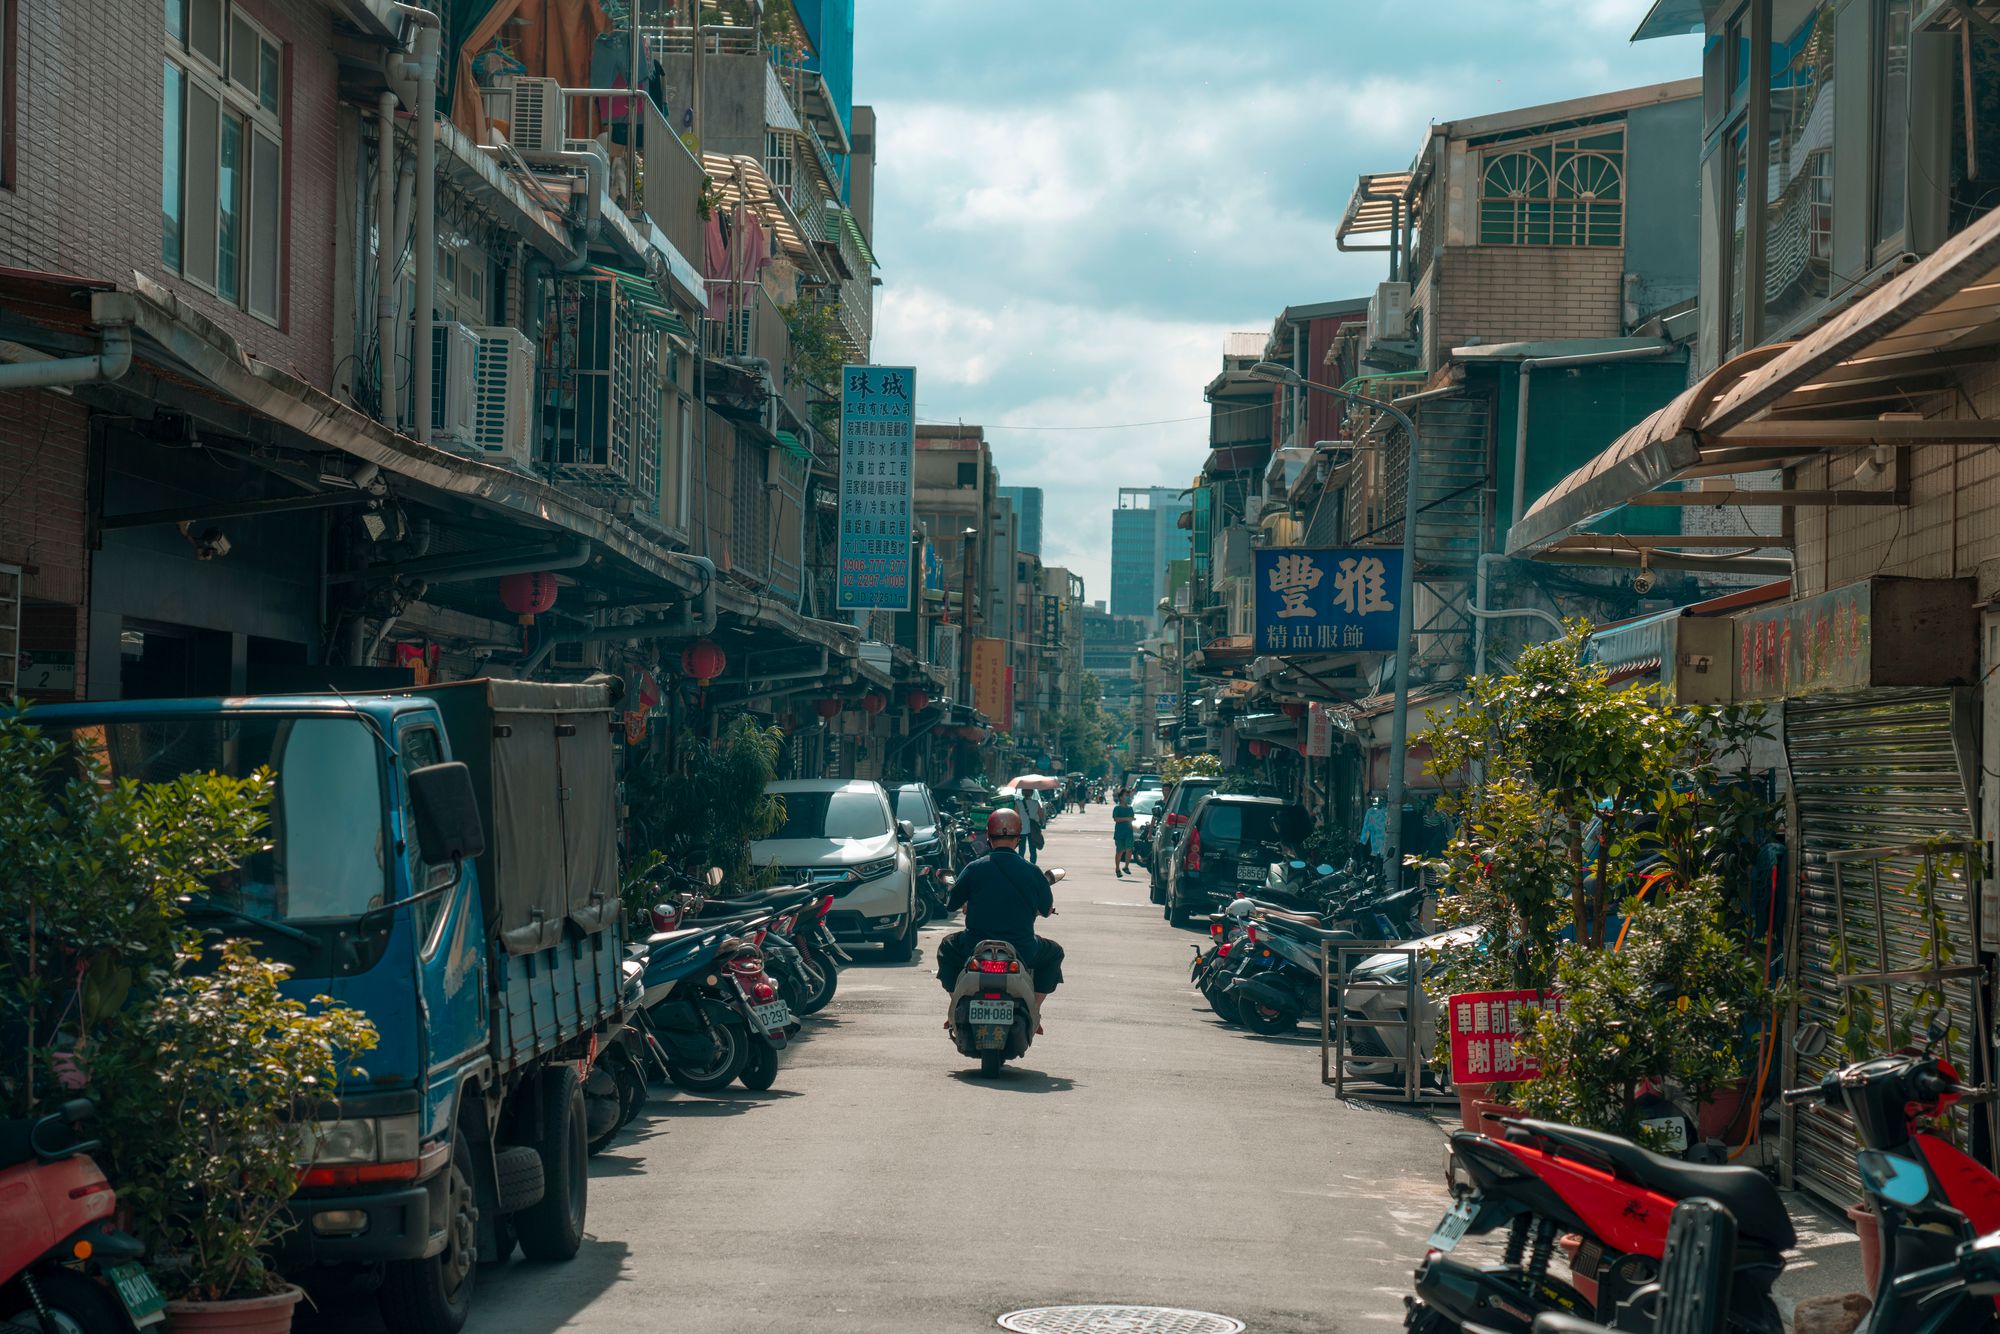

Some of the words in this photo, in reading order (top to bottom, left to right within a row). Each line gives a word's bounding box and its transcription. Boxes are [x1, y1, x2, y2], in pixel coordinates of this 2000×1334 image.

[846, 402, 911, 417] 工程有限公司
[843, 558, 907, 573] 0906-777-377
[842, 574, 905, 588] 02-2297-1009
[1268, 553, 1395, 619] 豐雅
[1266, 624, 1365, 649] 精品服飾
[39, 671, 50, 687] 2
[1457, 998, 1568, 1034] 車庫前請
